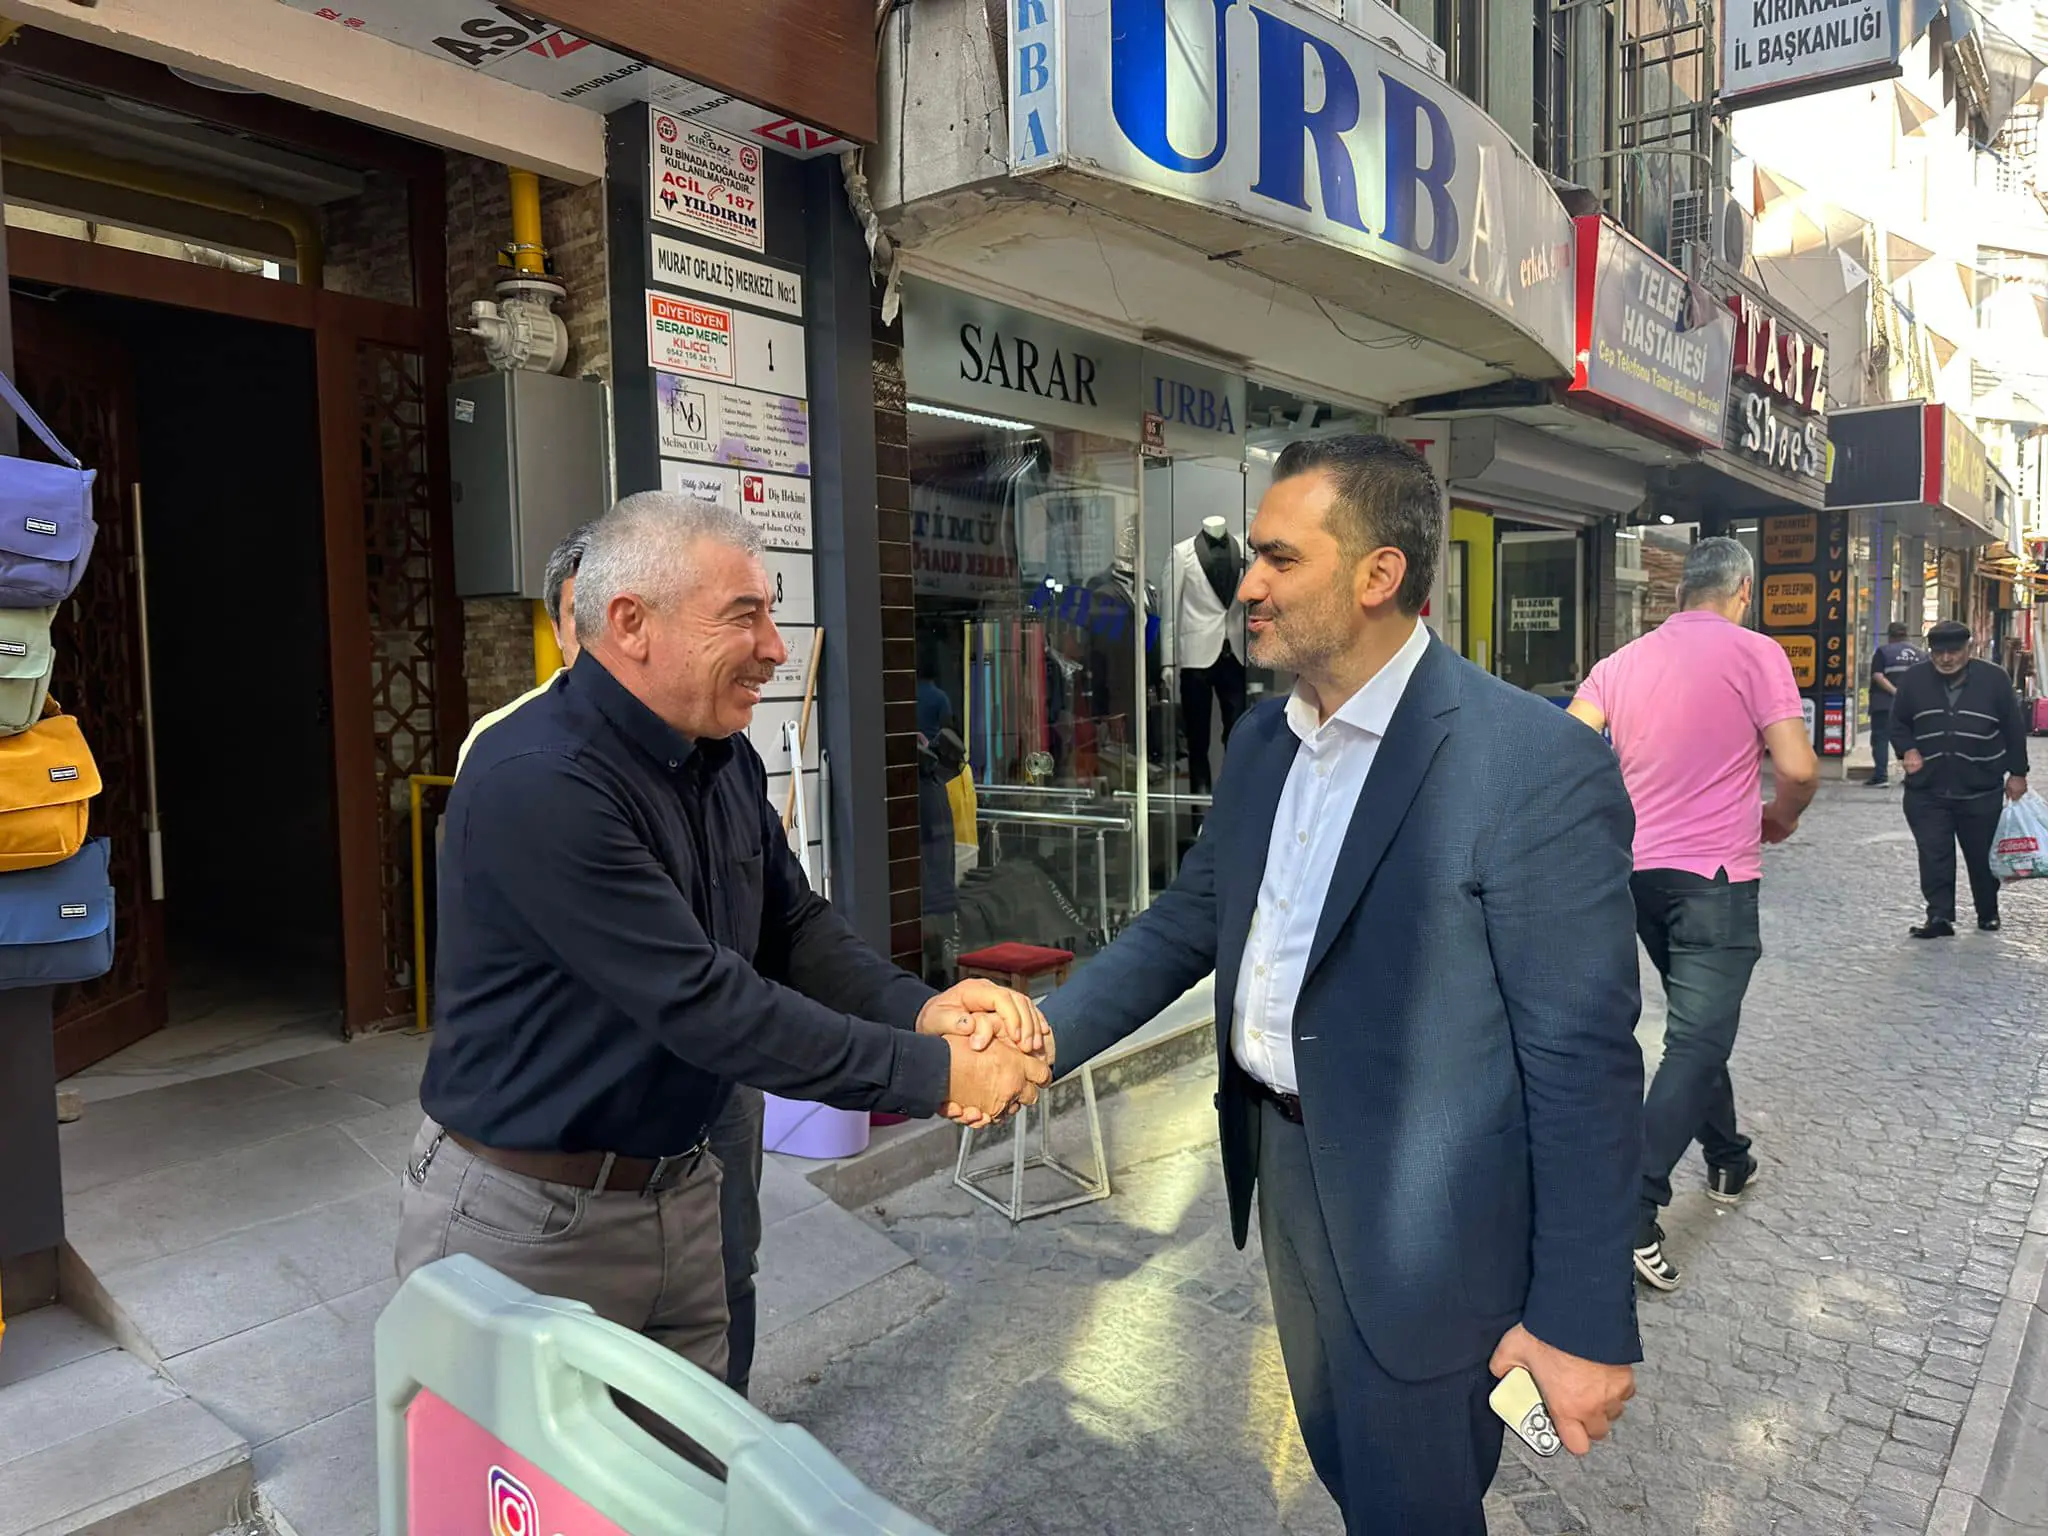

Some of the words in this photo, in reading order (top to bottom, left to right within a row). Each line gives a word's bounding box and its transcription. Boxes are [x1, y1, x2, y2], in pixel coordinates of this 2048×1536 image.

[1735, 38, 1752, 71] İL
[1758, 6, 1881, 66] BAŞKANLIĞI
[660, 144, 673, 156] BU
[675, 149, 708, 169] BİNADA
[710, 161, 756, 186] DOĞALGAZ
[1112, 0, 1513, 306] URBA
[662, 171, 704, 196] ACİL
[726, 193, 755, 211] 187
[682, 195, 757, 229] YILDIRIM
[658, 247, 691, 276] MURAT
[694, 258, 722, 284] OFLAZ
[724, 260, 734, 292] İŞ
[736, 269, 774, 298] MERKEZİ
[778, 281, 797, 304] No:1
[656, 319, 695, 338] SERAP
[696, 328, 729, 347] MERİÇ
[658, 301, 724, 329] DİYETİSYEN
[768, 339, 774, 372] 1
[1598, 339, 1614, 369] Cep
[1622, 305, 1708, 384] HASTANESİ
[960, 322, 1098, 407] SARAR
[1155, 376, 1236, 435] URBA
[750, 508, 770, 517] Kemal
[768, 488, 780, 504] Diş
[781, 489, 806, 503] Hekimi
[776, 572, 783, 604] 8
[1767, 584, 1780, 597] CEP
[1781, 582, 1814, 597] TELEFONU
[1825, 636, 1844, 687] GSM
